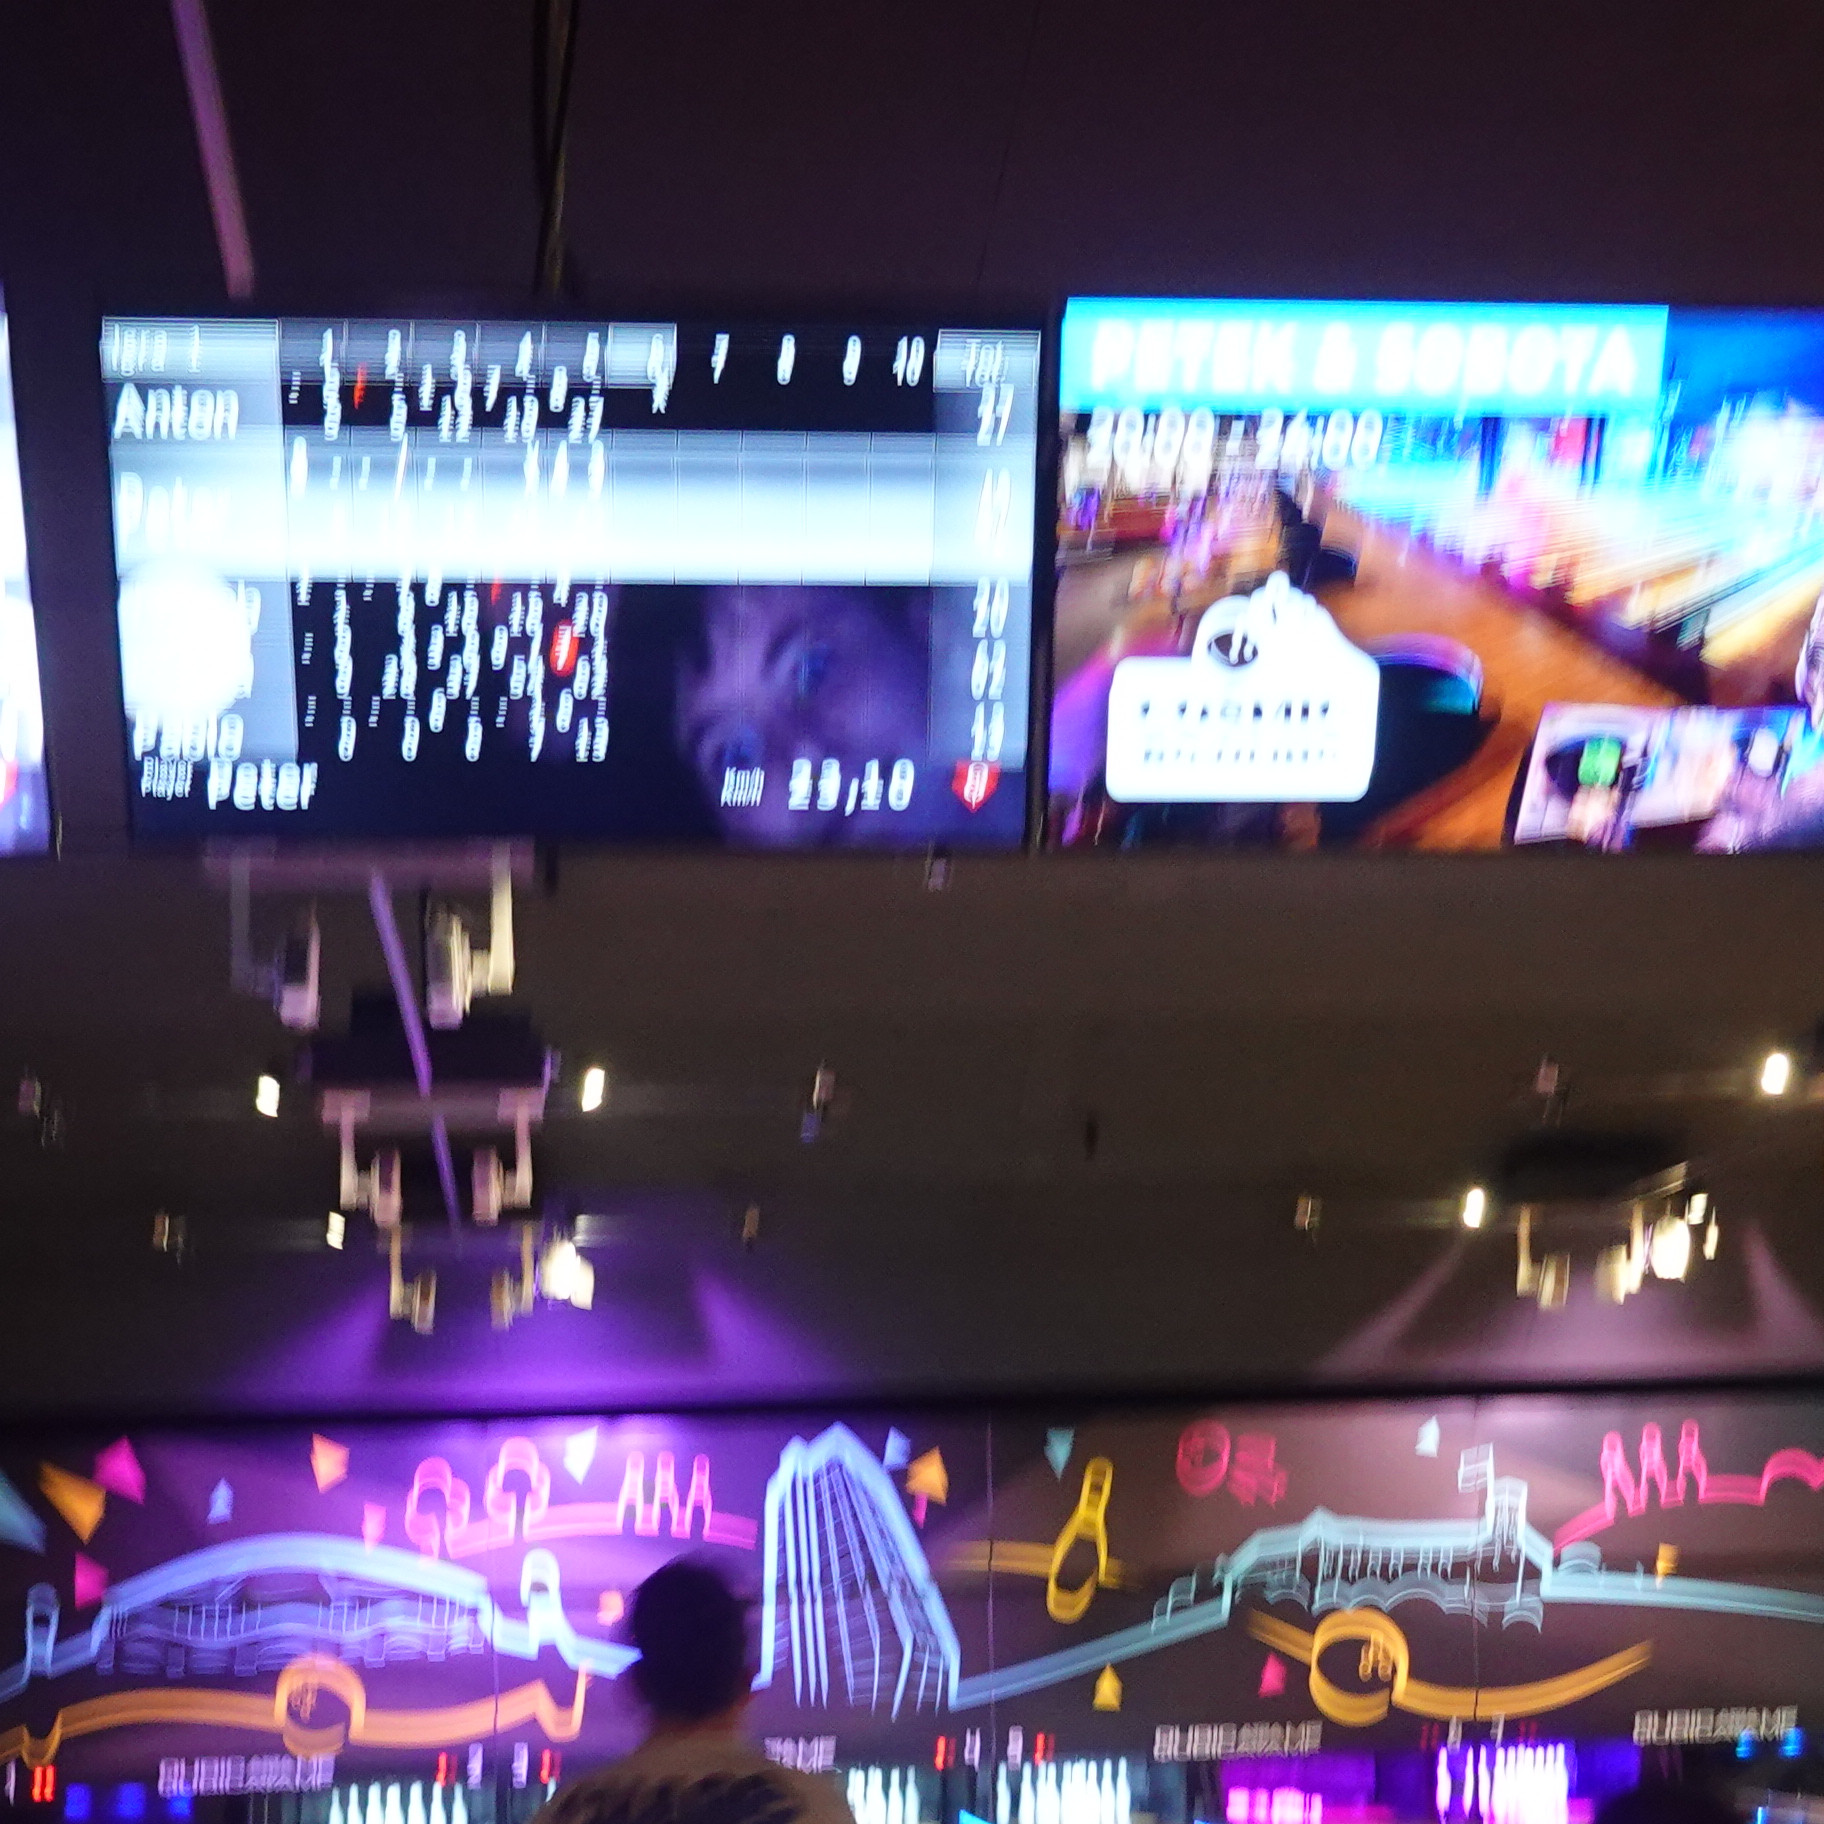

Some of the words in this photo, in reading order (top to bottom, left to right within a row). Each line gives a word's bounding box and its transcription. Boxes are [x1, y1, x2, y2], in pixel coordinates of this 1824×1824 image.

[1091, 318, 1297, 394] PETEK
[1375, 322, 1637, 396] SOBOTA
[113, 383, 240, 441] Anton
[206, 757, 319, 812] Peter
